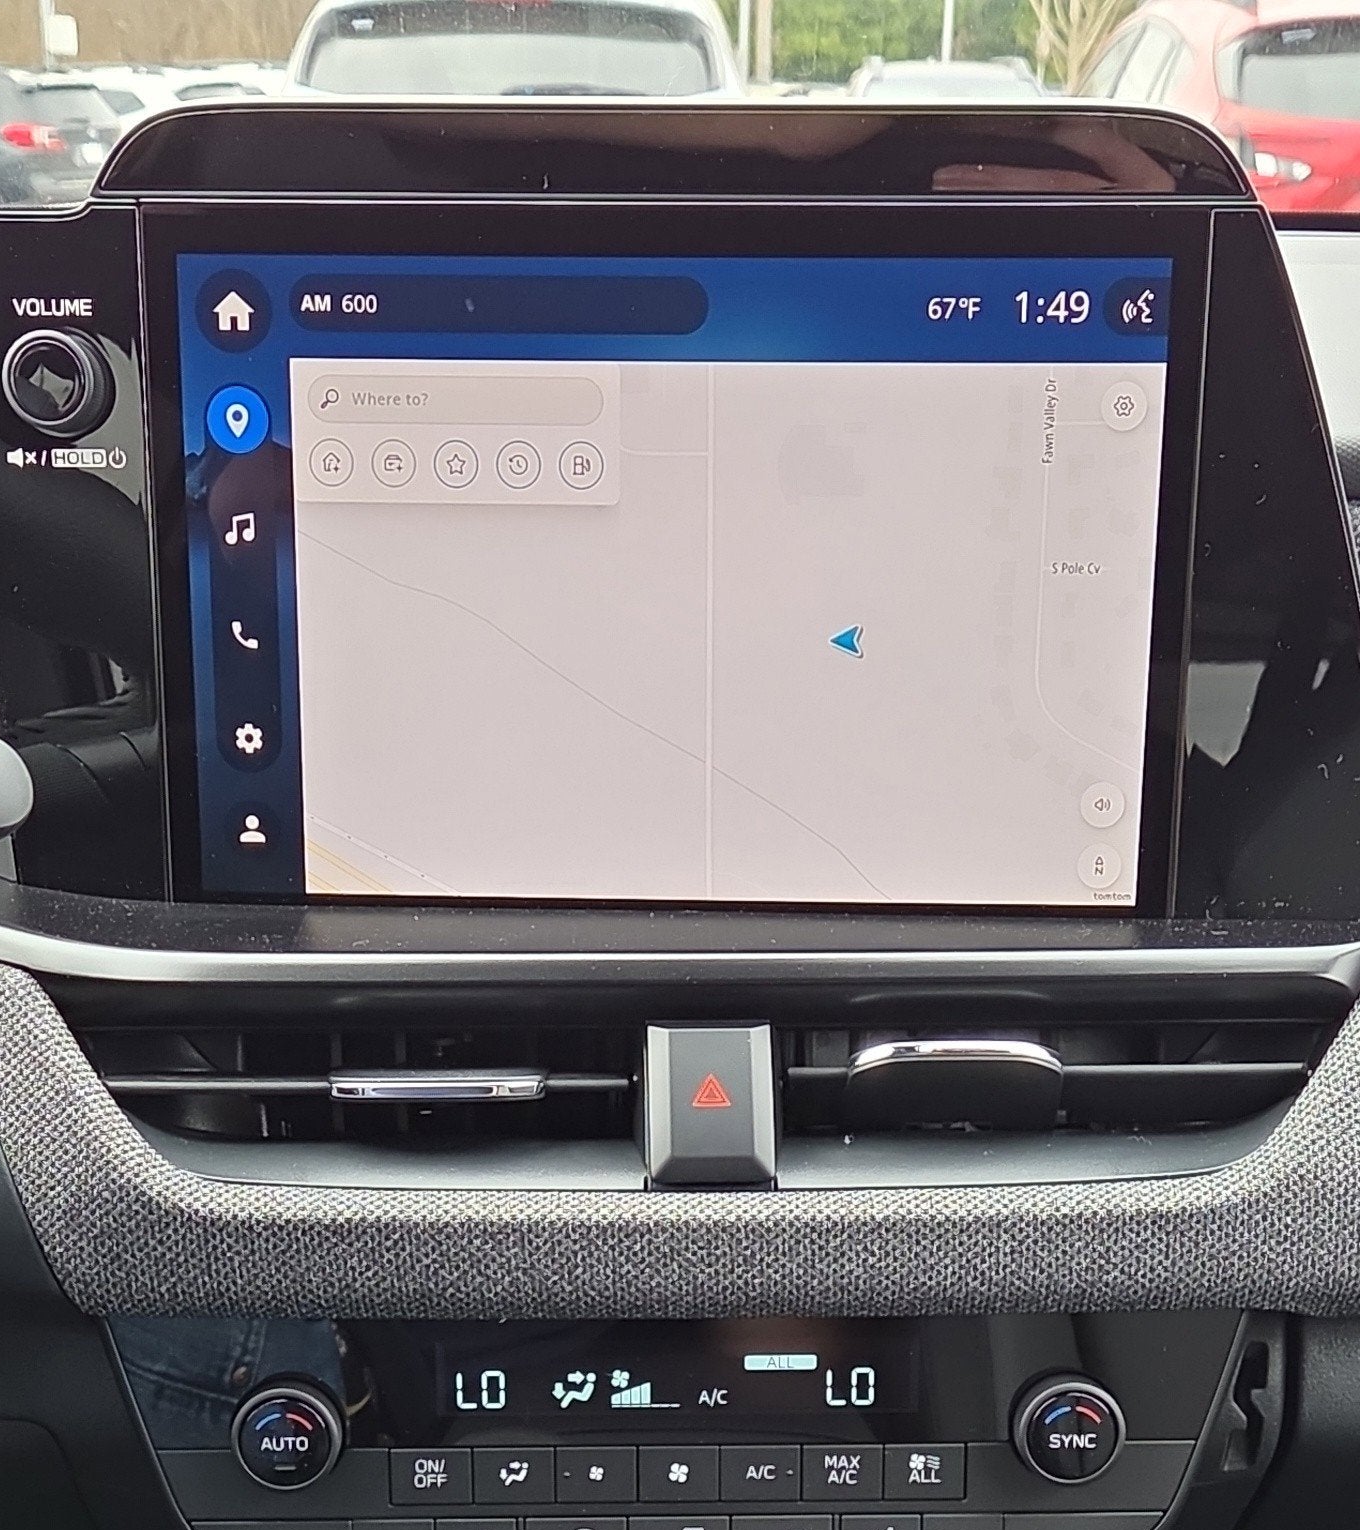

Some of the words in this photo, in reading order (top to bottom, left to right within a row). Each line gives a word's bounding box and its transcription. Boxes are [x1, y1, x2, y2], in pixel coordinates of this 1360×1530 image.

[12, 298, 93, 317] VOLUME
[300, 294, 332, 312] AM
[341, 294, 378, 313] 600
[1014, 290, 1090, 323] 1:49
[1045, 378, 1057, 392] Dr
[351, 392, 401, 406] Where
[406, 392, 429, 406] to?
[1043, 394, 1059, 430] Valley
[1041, 432, 1055, 464] Fawn
[53, 451, 105, 465] HOLD
[1052, 562, 1058, 574] S
[1061, 562, 1085, 574] Pole
[1087, 562, 1101, 574] Cv
[766, 1357, 795, 1368] ALL
[455, 1370, 506, 1410] LO
[825, 1366, 875, 1406] LO
[698, 1388, 728, 1408] A/C
[260, 1436, 309, 1452] AUTO
[1048, 1433, 1097, 1449] SYNC
[414, 1458, 445, 1475] ON/
[824, 1455, 861, 1469] MAX
[745, 1464, 776, 1480] A/C
[827, 1470, 858, 1485] A/C
[908, 1470, 942, 1484] ALL
[413, 1473, 448, 1489] OFF
